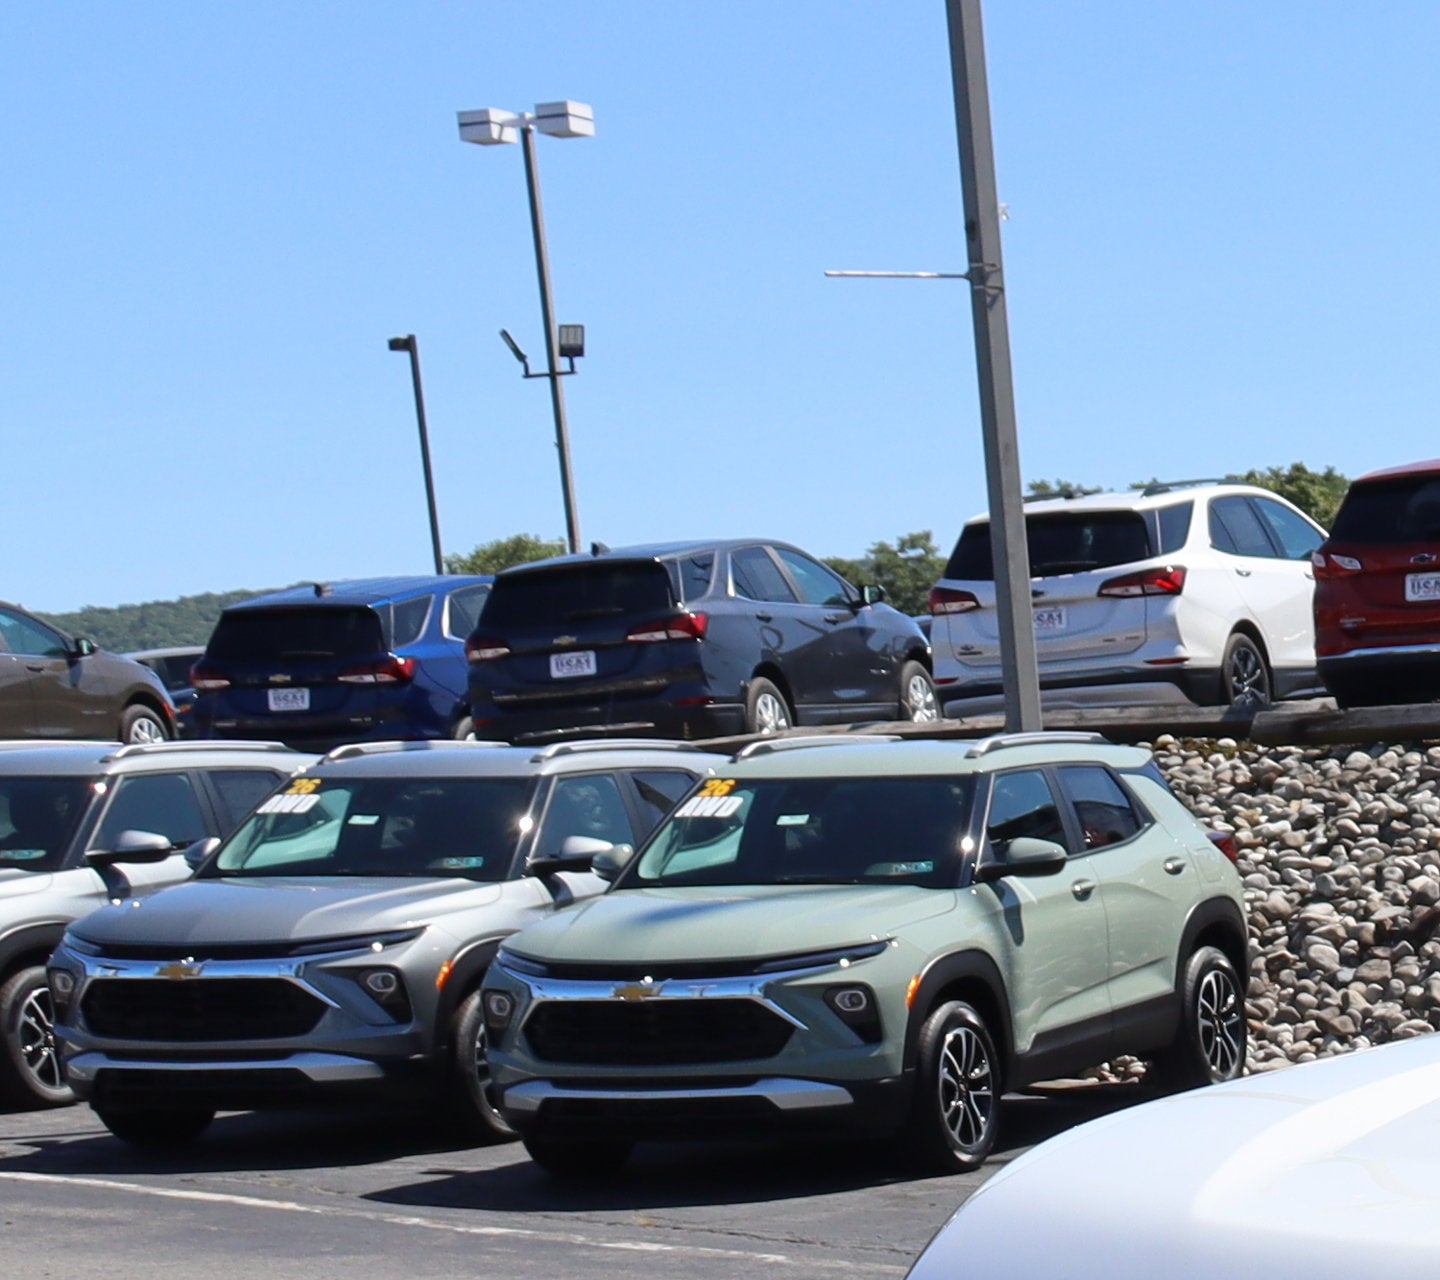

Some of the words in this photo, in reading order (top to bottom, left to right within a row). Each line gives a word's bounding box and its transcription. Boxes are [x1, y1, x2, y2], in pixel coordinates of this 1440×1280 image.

[1032, 611, 1063, 626] SA1
[283, 777, 322, 795] 26
[695, 777, 736, 797] 26
[673, 795, 744, 818] AWD
